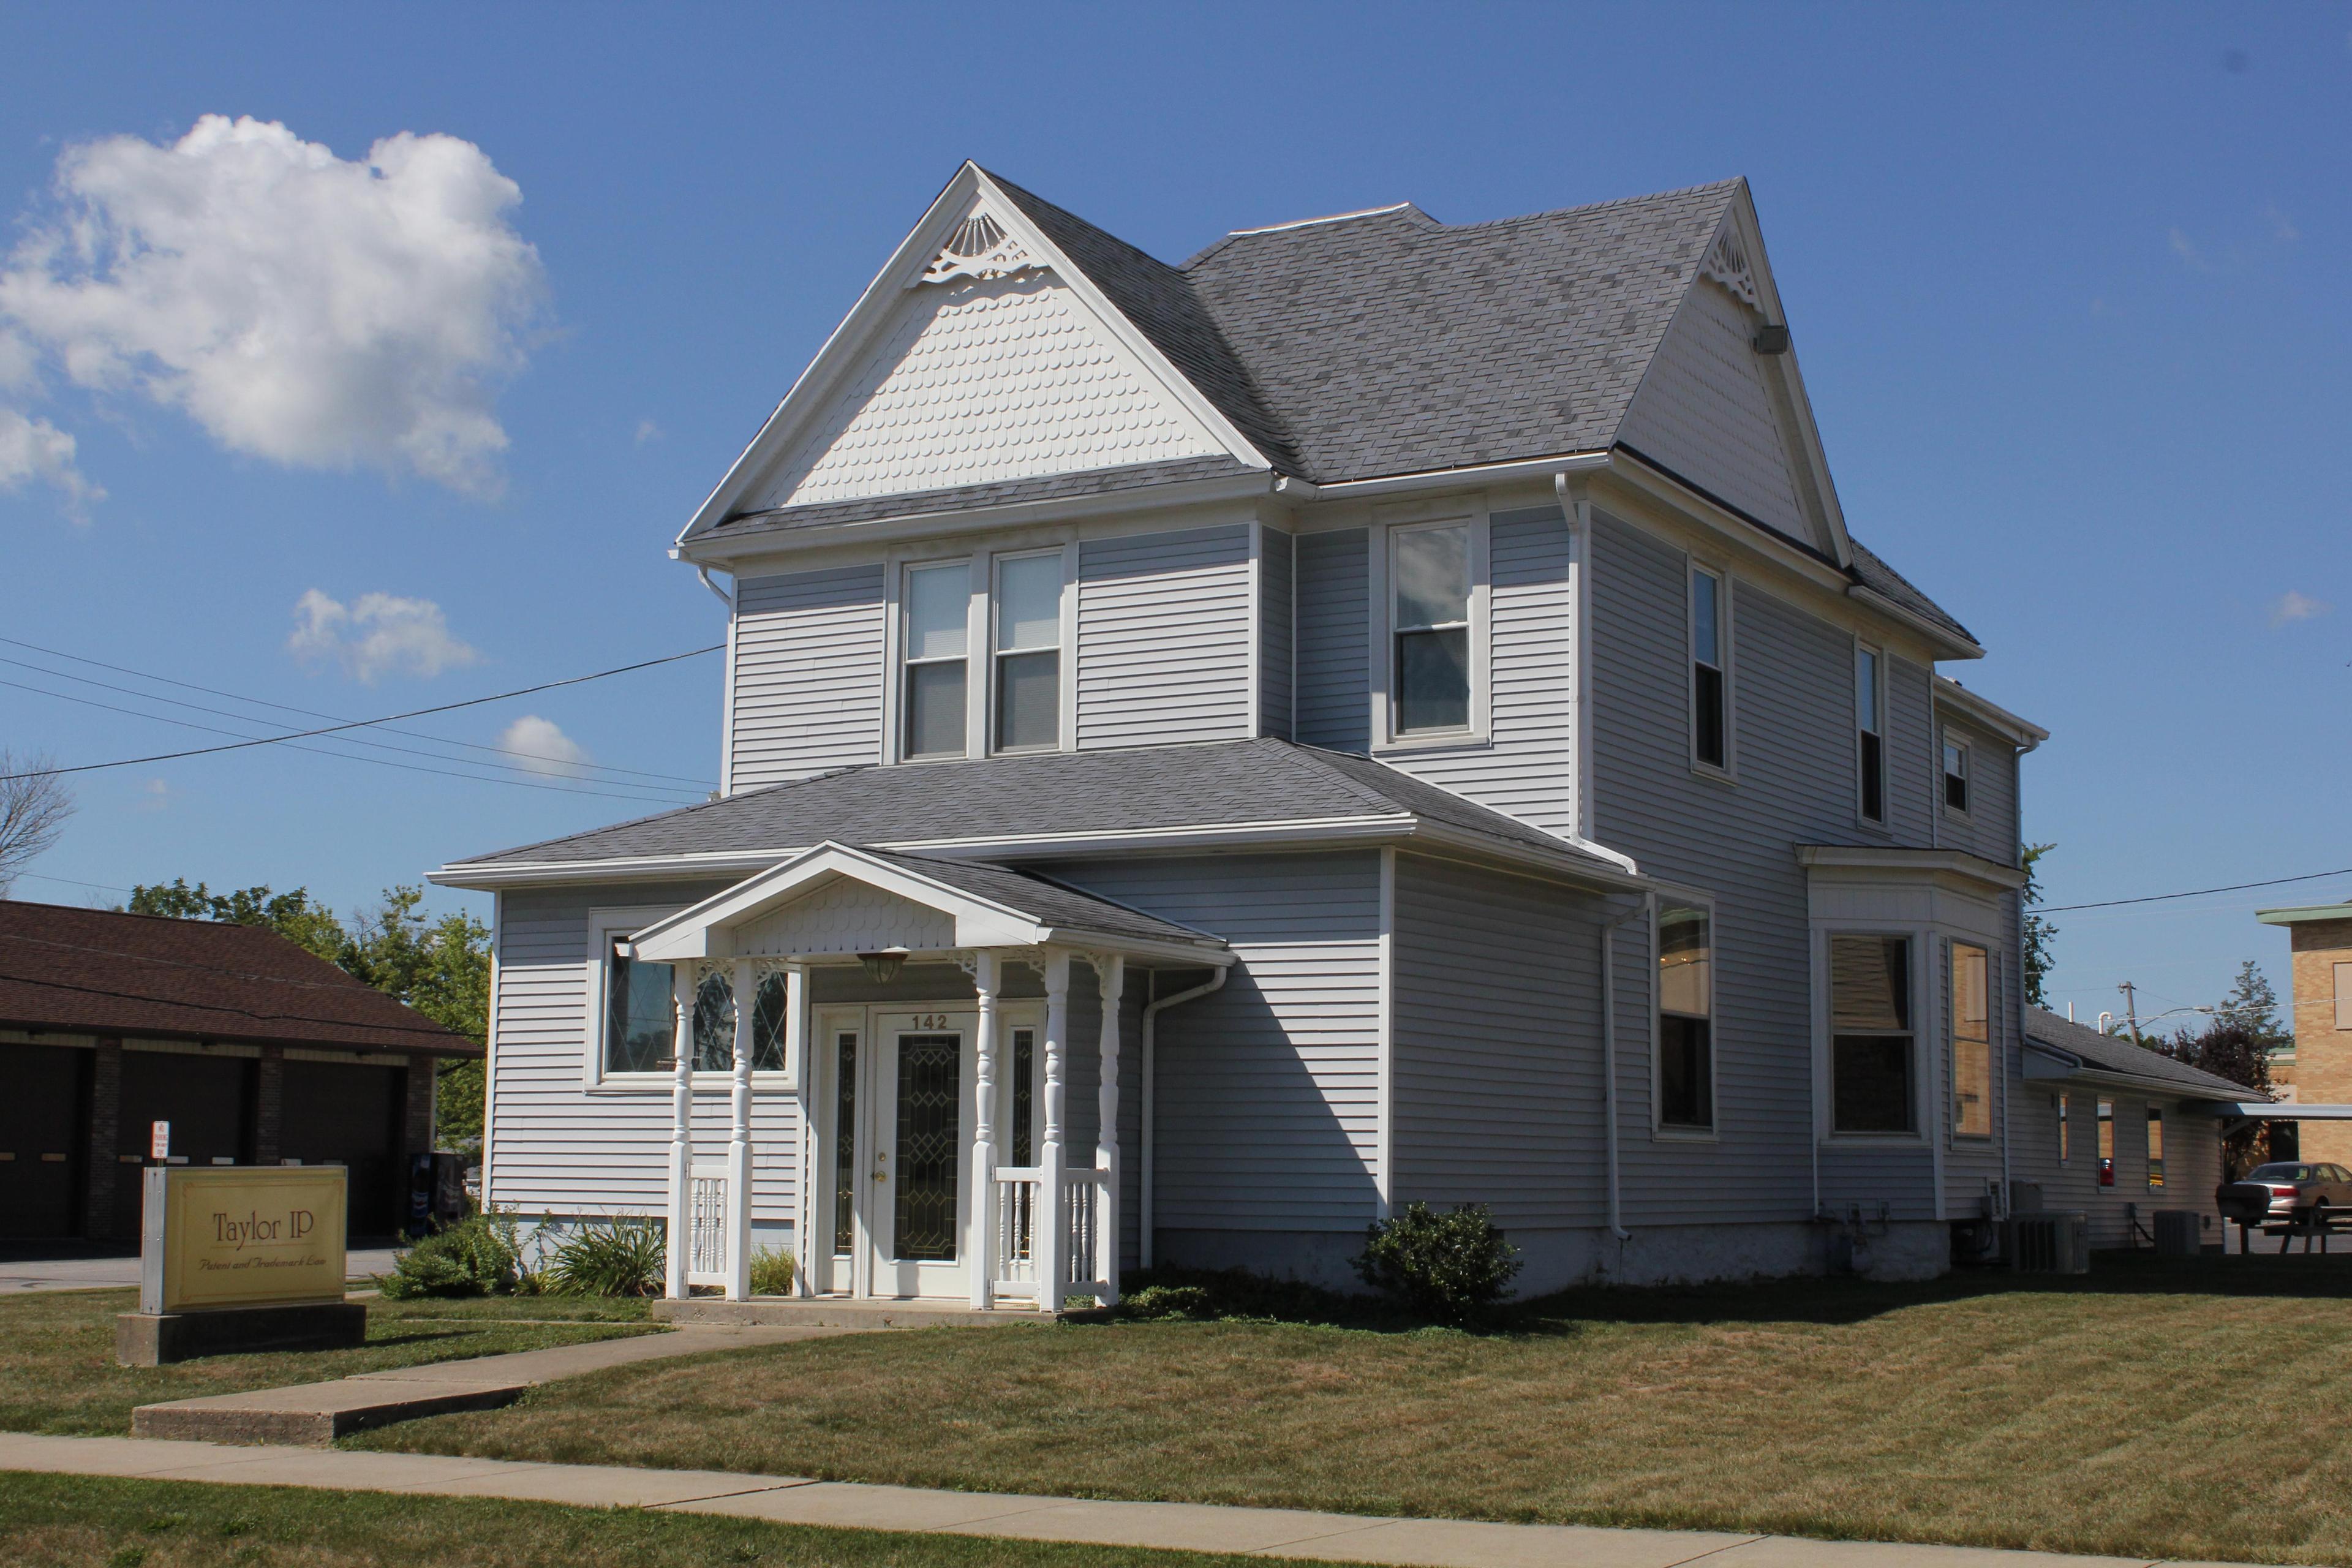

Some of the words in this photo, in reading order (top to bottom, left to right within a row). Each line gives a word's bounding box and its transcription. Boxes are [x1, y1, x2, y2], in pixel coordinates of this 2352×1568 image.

[912, 1014, 946, 1030] 142
[214, 1210, 281, 1251] Taylor
[290, 1210, 314, 1238] IP
[199, 1259, 231, 1270] Patent
[233, 1257, 252, 1268] and
[253, 1256, 304, 1268] Trademark
[306, 1255, 326, 1265] Law
